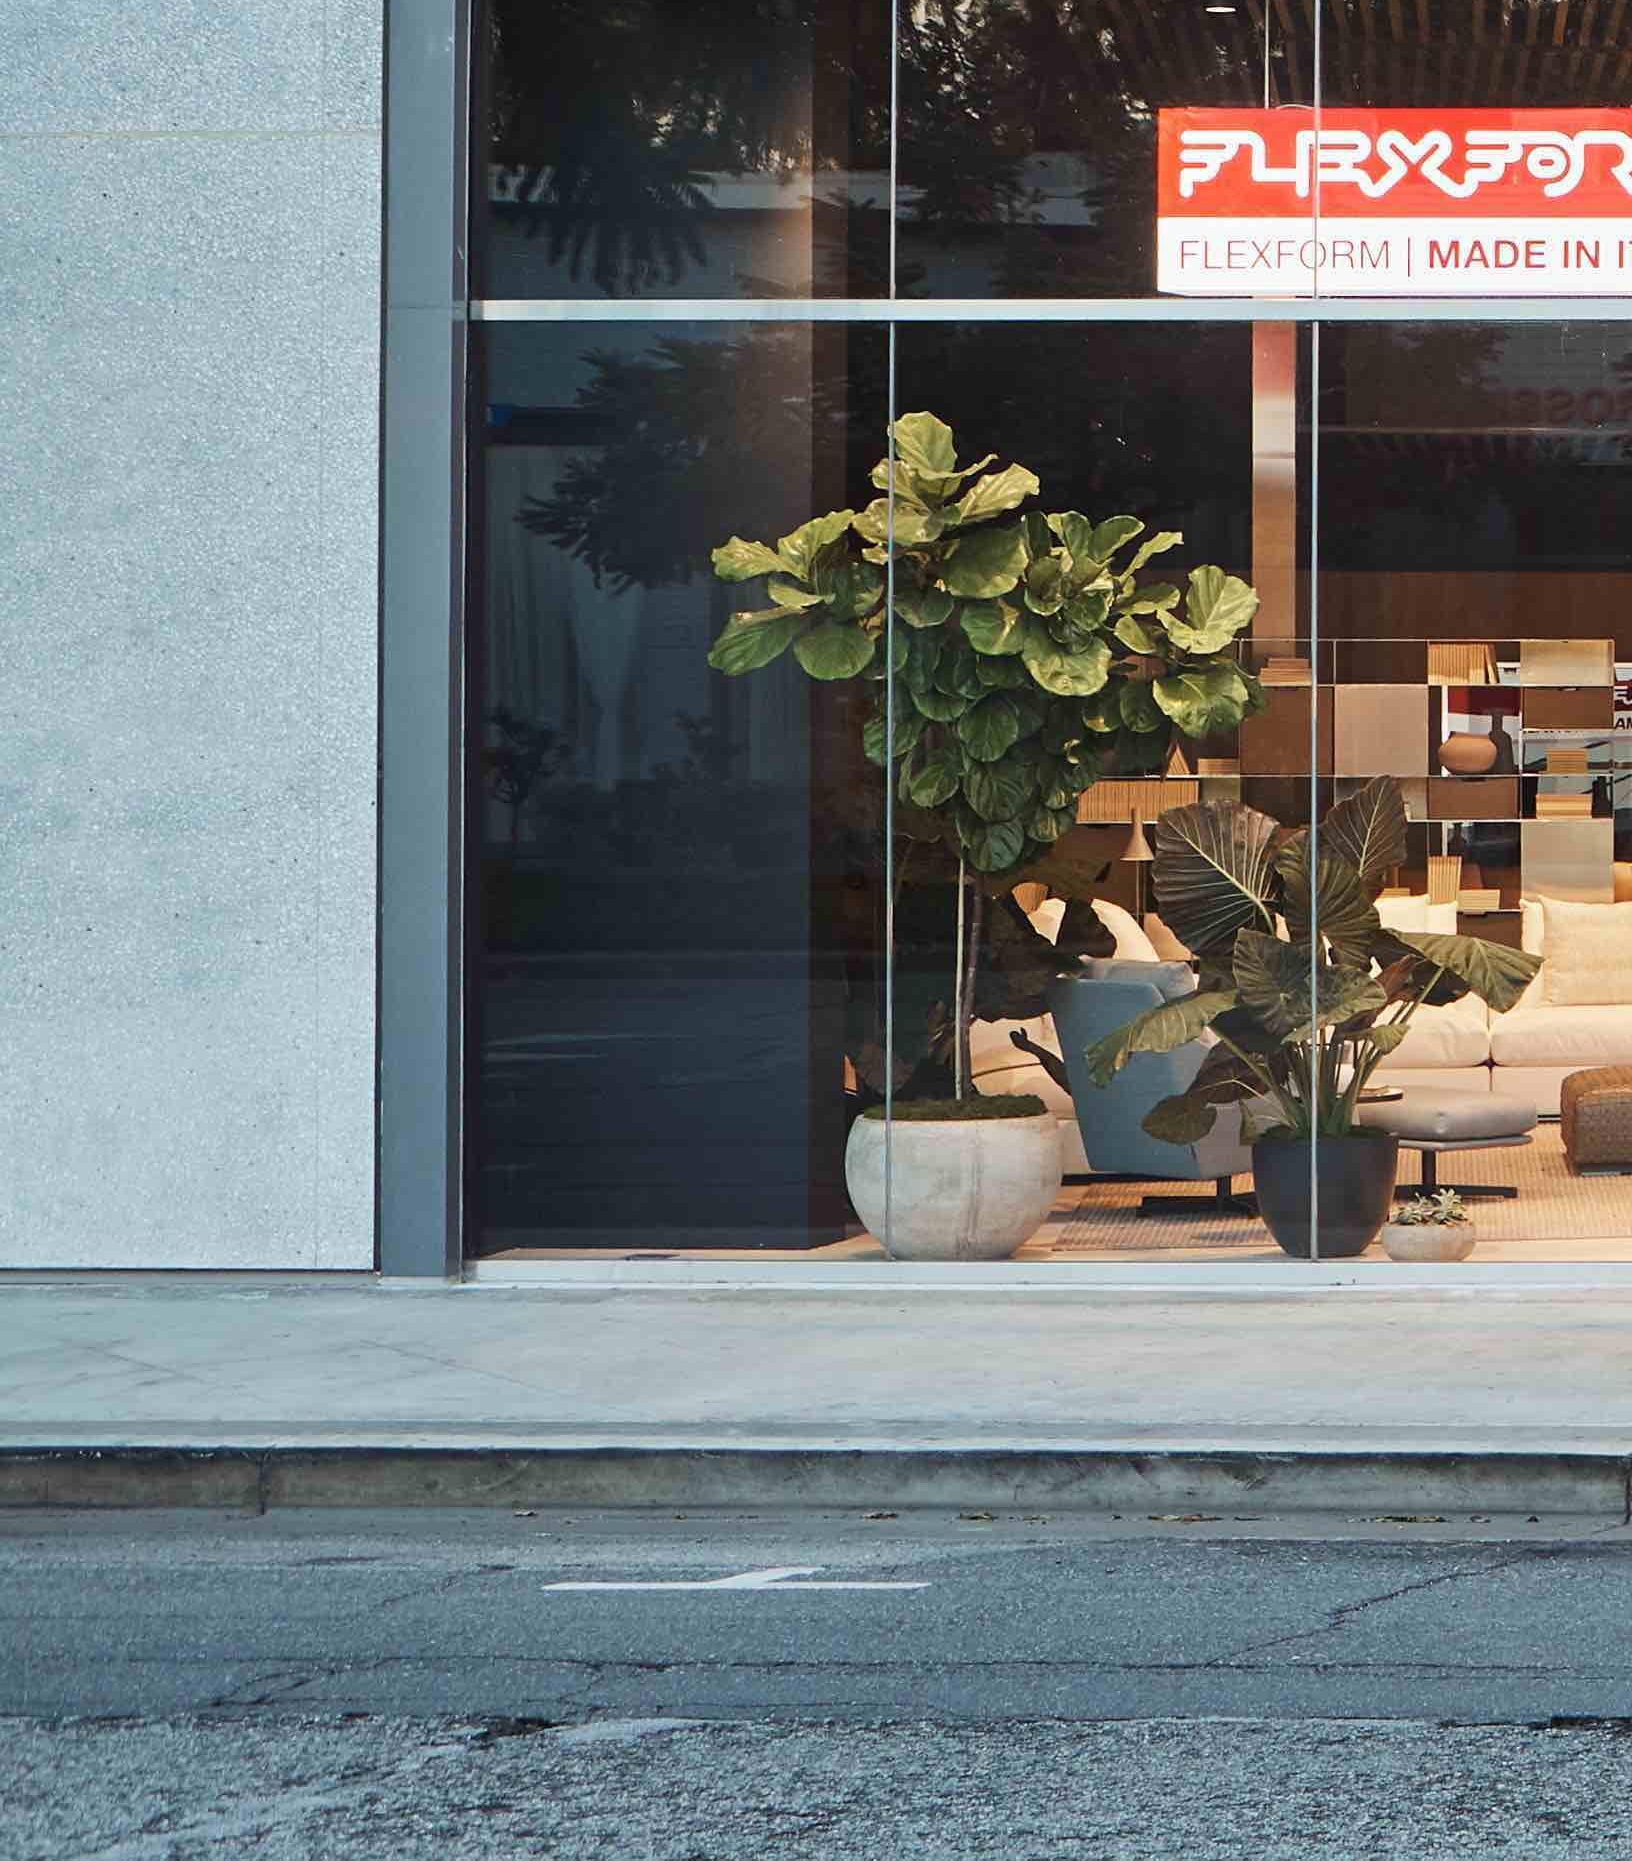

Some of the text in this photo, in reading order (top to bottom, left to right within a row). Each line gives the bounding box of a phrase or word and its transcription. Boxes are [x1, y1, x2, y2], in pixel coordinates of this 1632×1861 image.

[1180, 239, 1390, 269] FLEXFORM
[1428, 239, 1546, 269] MADE
[1562, 239, 1602, 269] IN
